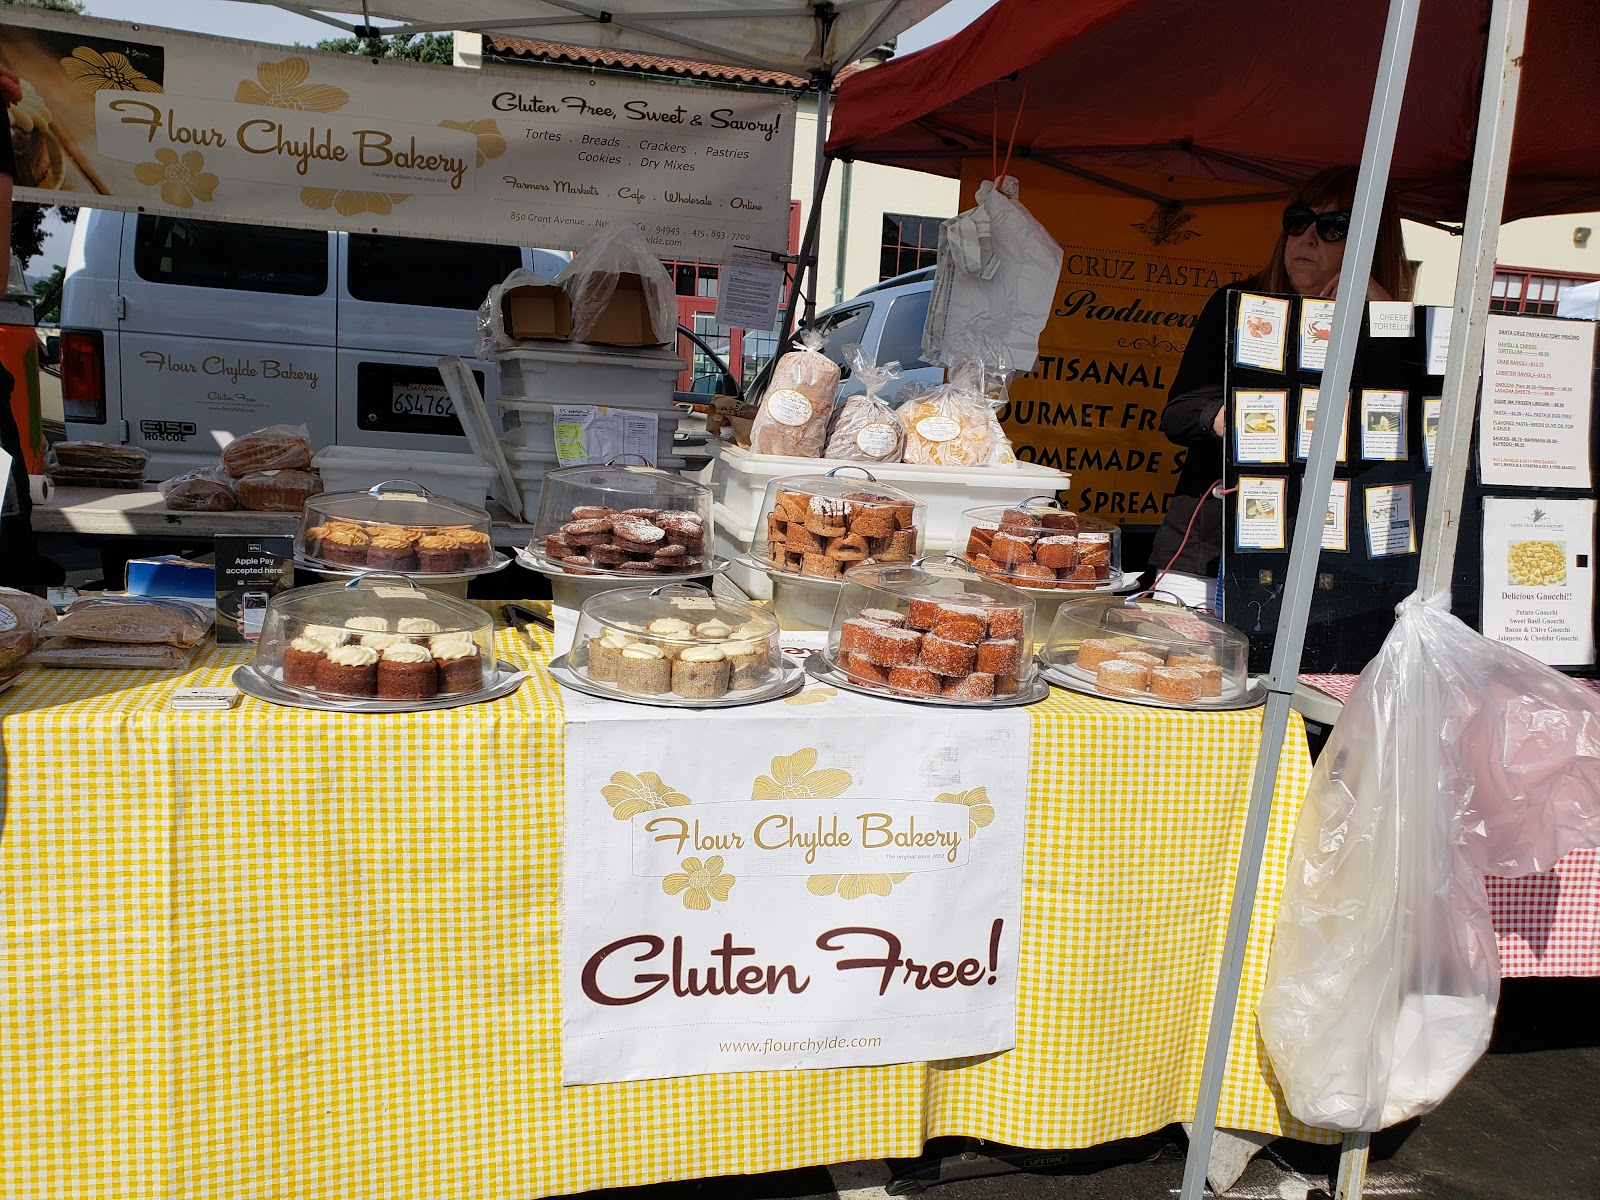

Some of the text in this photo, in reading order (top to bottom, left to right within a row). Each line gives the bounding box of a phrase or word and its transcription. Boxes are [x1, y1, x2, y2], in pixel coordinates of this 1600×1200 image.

[492, 92, 781, 142] Gluten Free, Sweet & Savory!
[108, 99, 468, 190] Flour Chylde Bakery
[525, 128, 750, 160] Tortes Breads Crackers Pastries
[578, 151, 696, 172] Cookies Dry Mixes
[502, 175, 763, 211] Farmers Markets Cafe Wholesale Online
[510, 212, 526, 222] 850
[528, 213, 552, 224] Grant
[553, 215, 585, 226] Avenue
[656, 225, 681, 236] 94945
[1066, 254, 1136, 280] CRUZ
[1145, 262, 1220, 289] PASTA
[1374, 322, 1414, 331] TORTELLINI
[1380, 313, 1409, 321] CHEESE
[139, 351, 319, 389] Flour Chylde Bakery
[1024, 355, 1166, 390] TISANAL
[207, 391, 234, 400] Gluten
[394, 394, 457, 416] 6S4762
[997, 400, 1114, 428] OURMET
[145, 432, 187, 443] ROSCOE
[1015, 445, 1163, 474] OMEMADE
[226, 567, 263, 575] accepted
[260, 558, 274, 566] Pay
[1502, 592, 1572, 601] Delicious Gnocchi!!
[644, 812, 962, 865] Flour Chylde Bakery
[581, 917, 1005, 1007] Gluten Free!
[718, 1034, 883, 1057] www.flourchylde.com
[1030, 1156, 1062, 1166] LIFETIME
